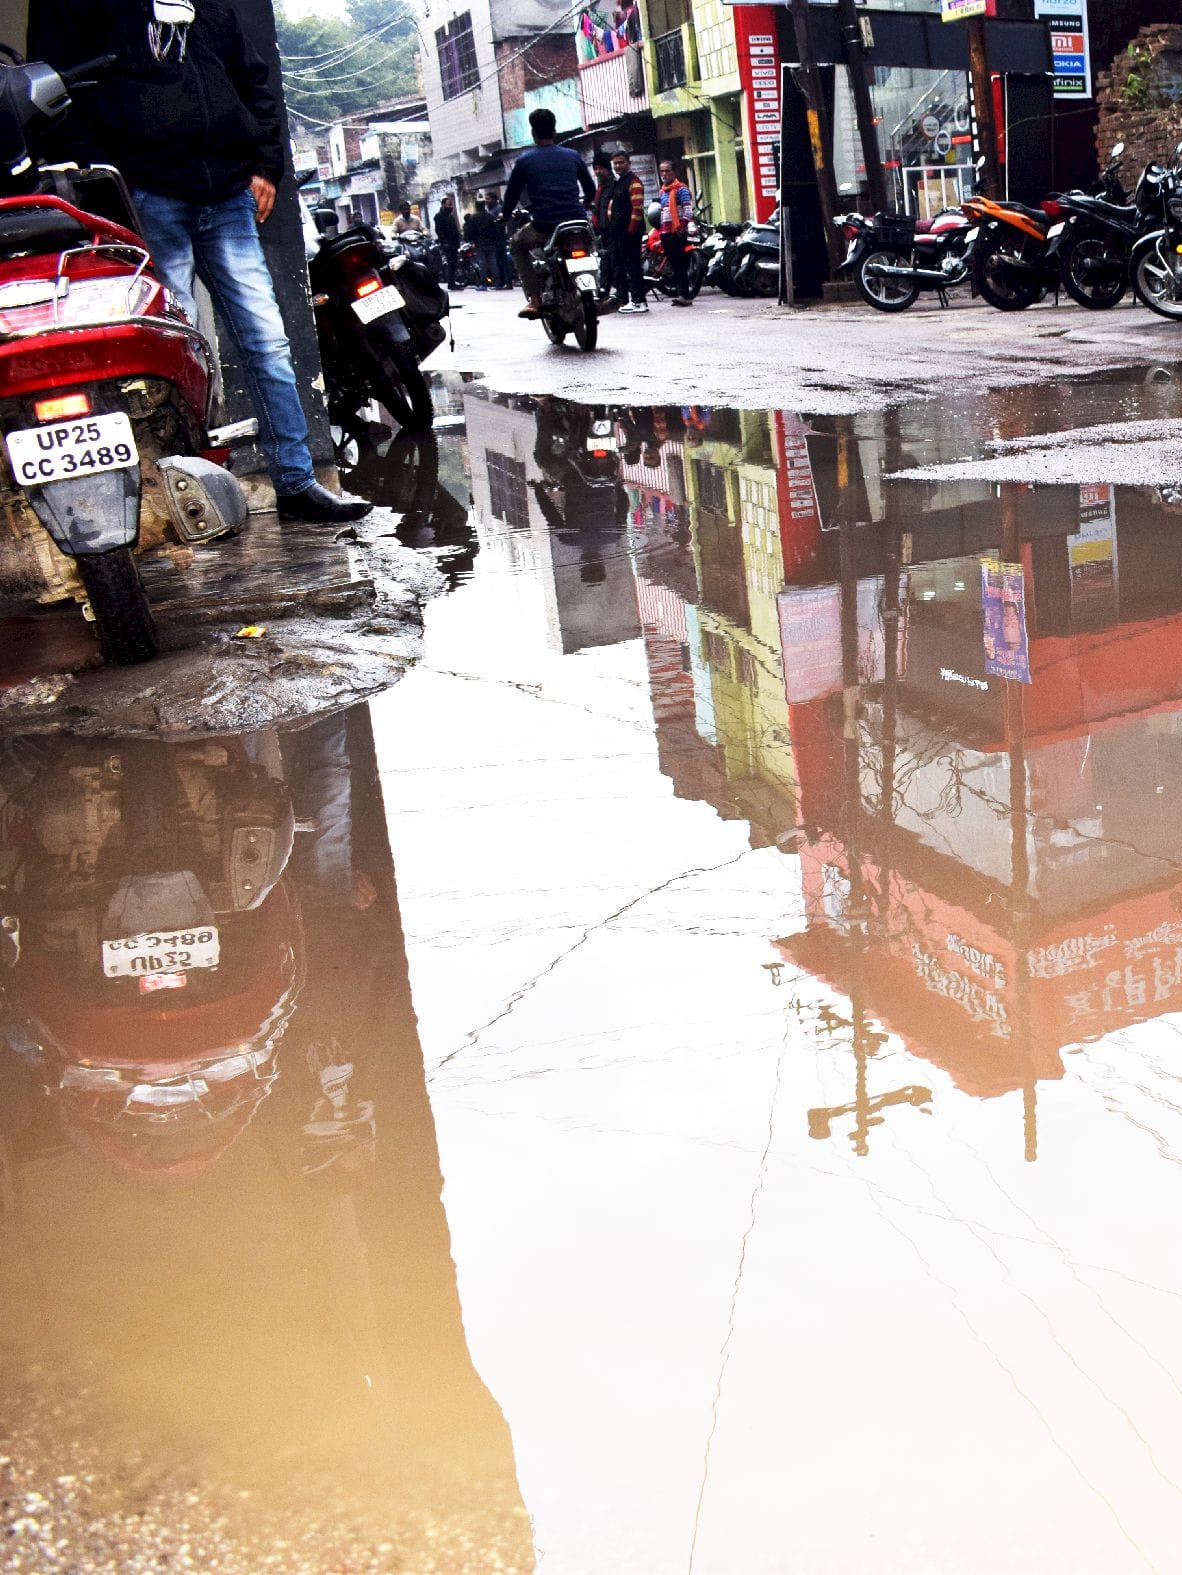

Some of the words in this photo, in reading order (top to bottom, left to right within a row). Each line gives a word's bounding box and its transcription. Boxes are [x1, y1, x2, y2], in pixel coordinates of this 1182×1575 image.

[36, 422, 101, 451] UP25
[21, 458, 55, 480] CC
[60, 443, 132, 473] 3489
